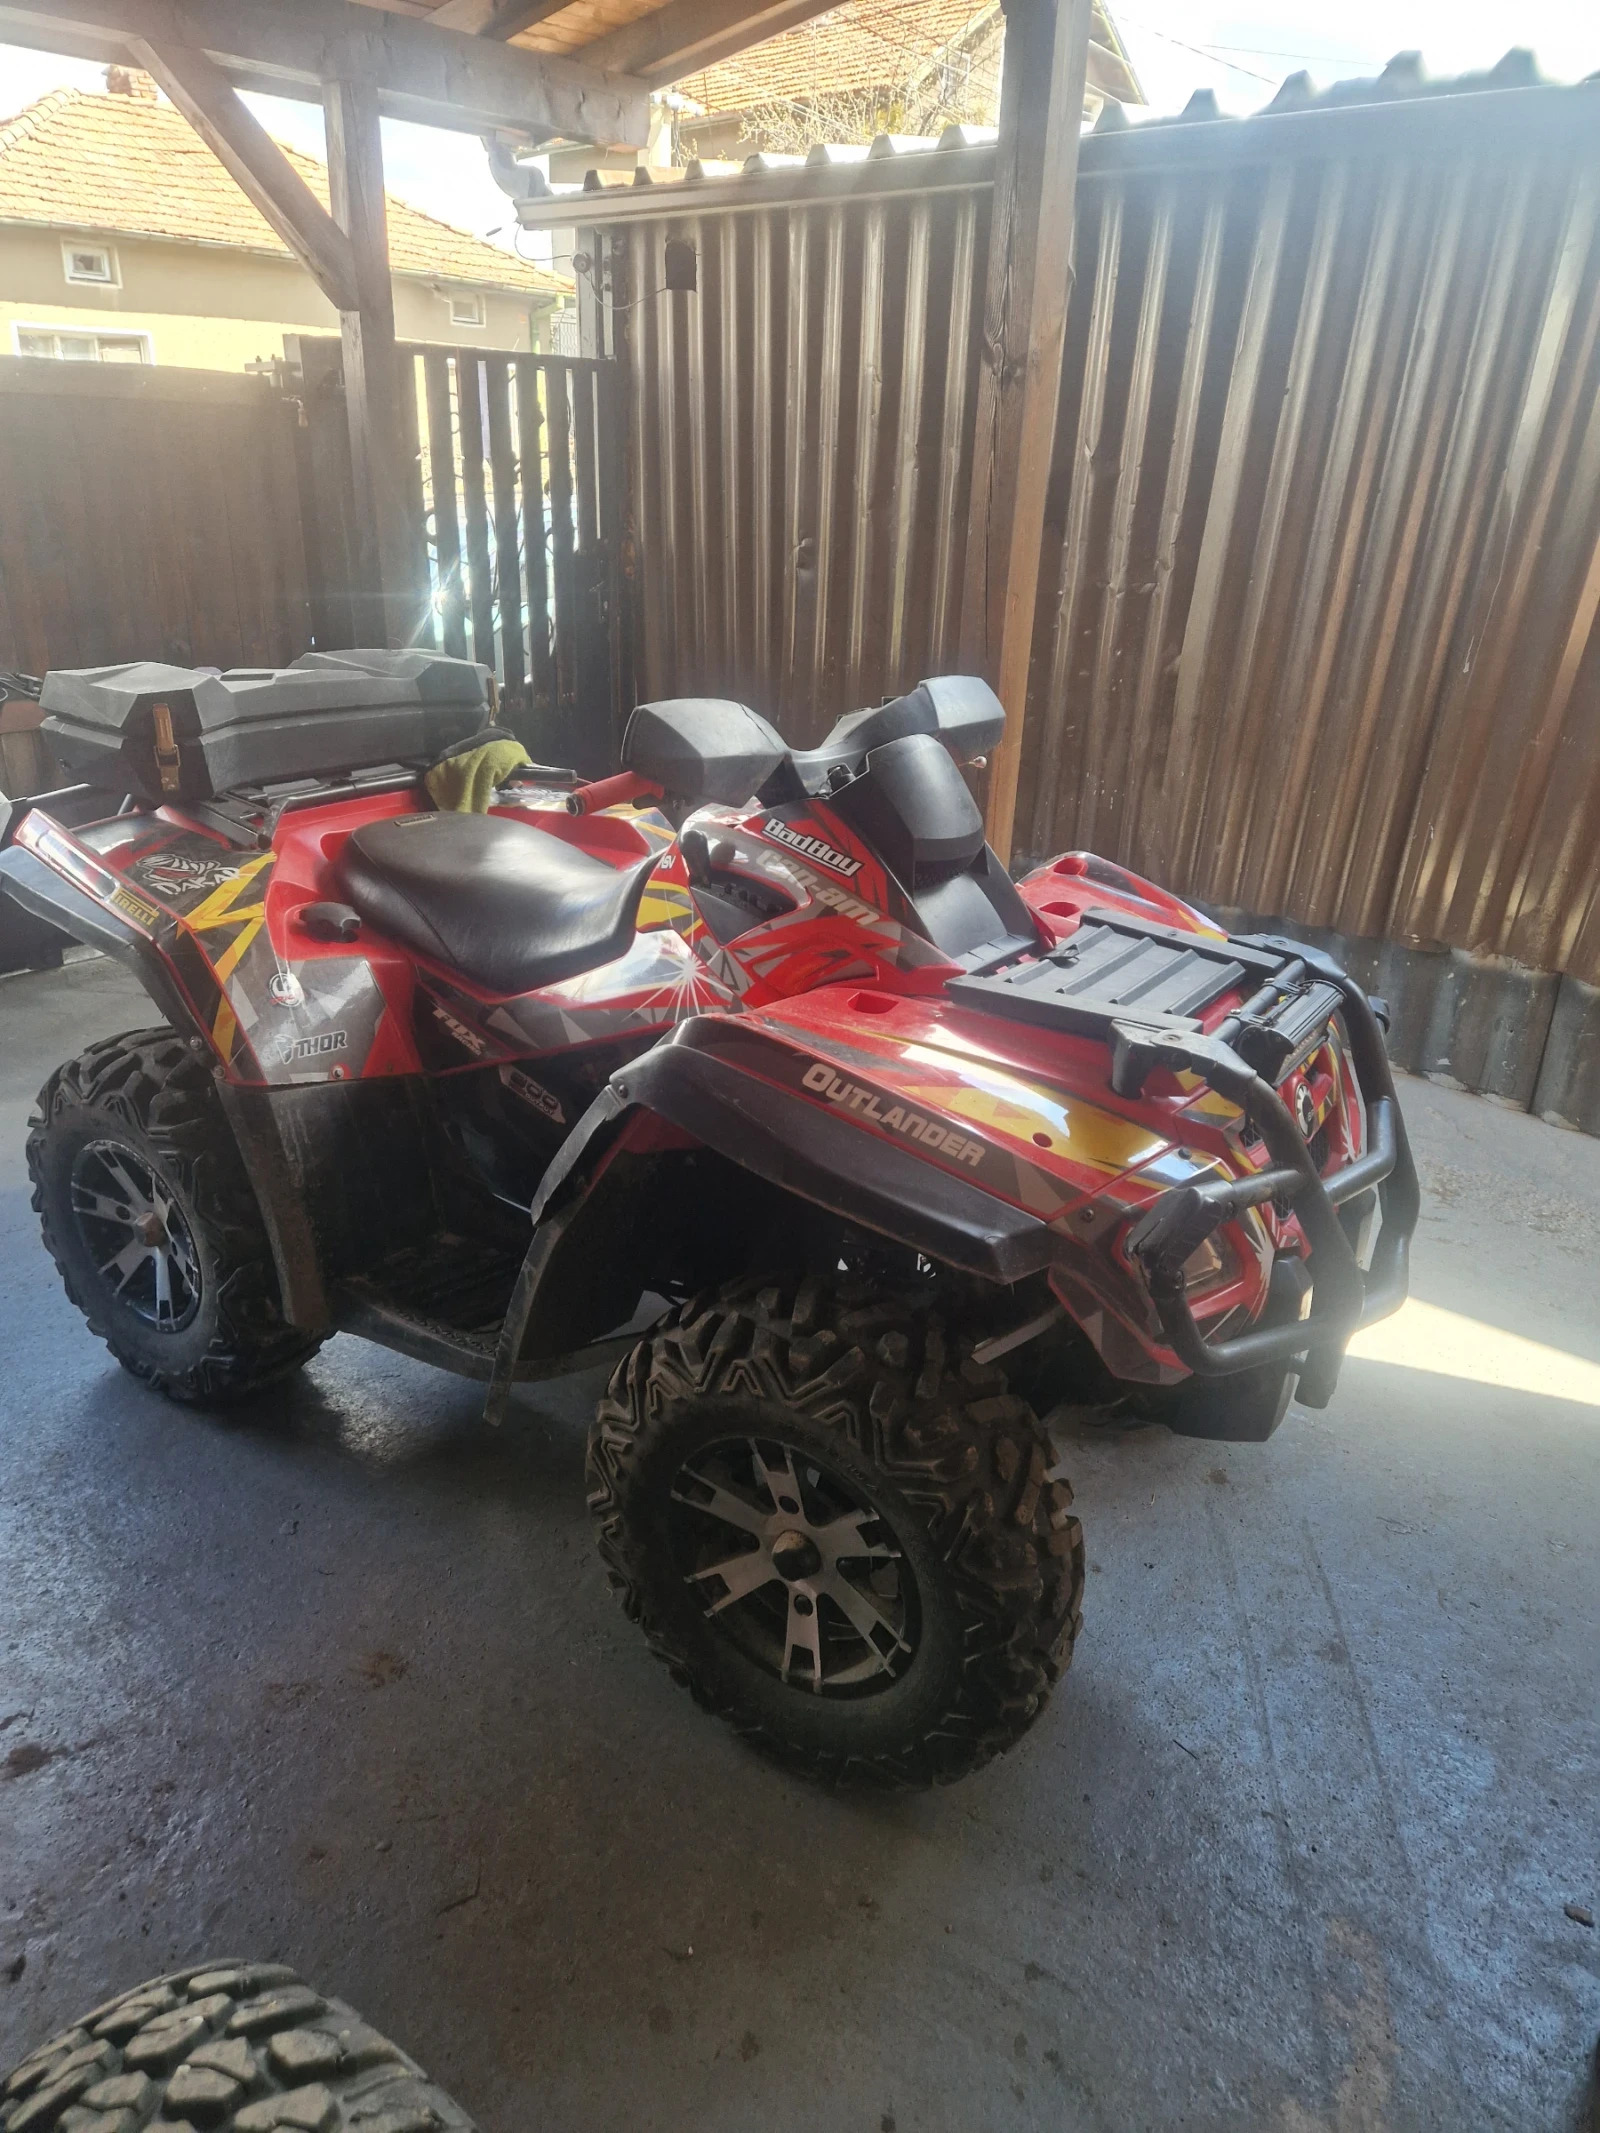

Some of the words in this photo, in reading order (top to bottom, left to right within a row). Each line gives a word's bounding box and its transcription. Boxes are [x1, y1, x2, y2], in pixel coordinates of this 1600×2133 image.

[763, 818, 864, 875] BadBoy
[109, 887, 160, 925] PIRELLI
[294, 1030, 348, 1059] THOR
[802, 1063, 986, 1167] OUTLANDER
